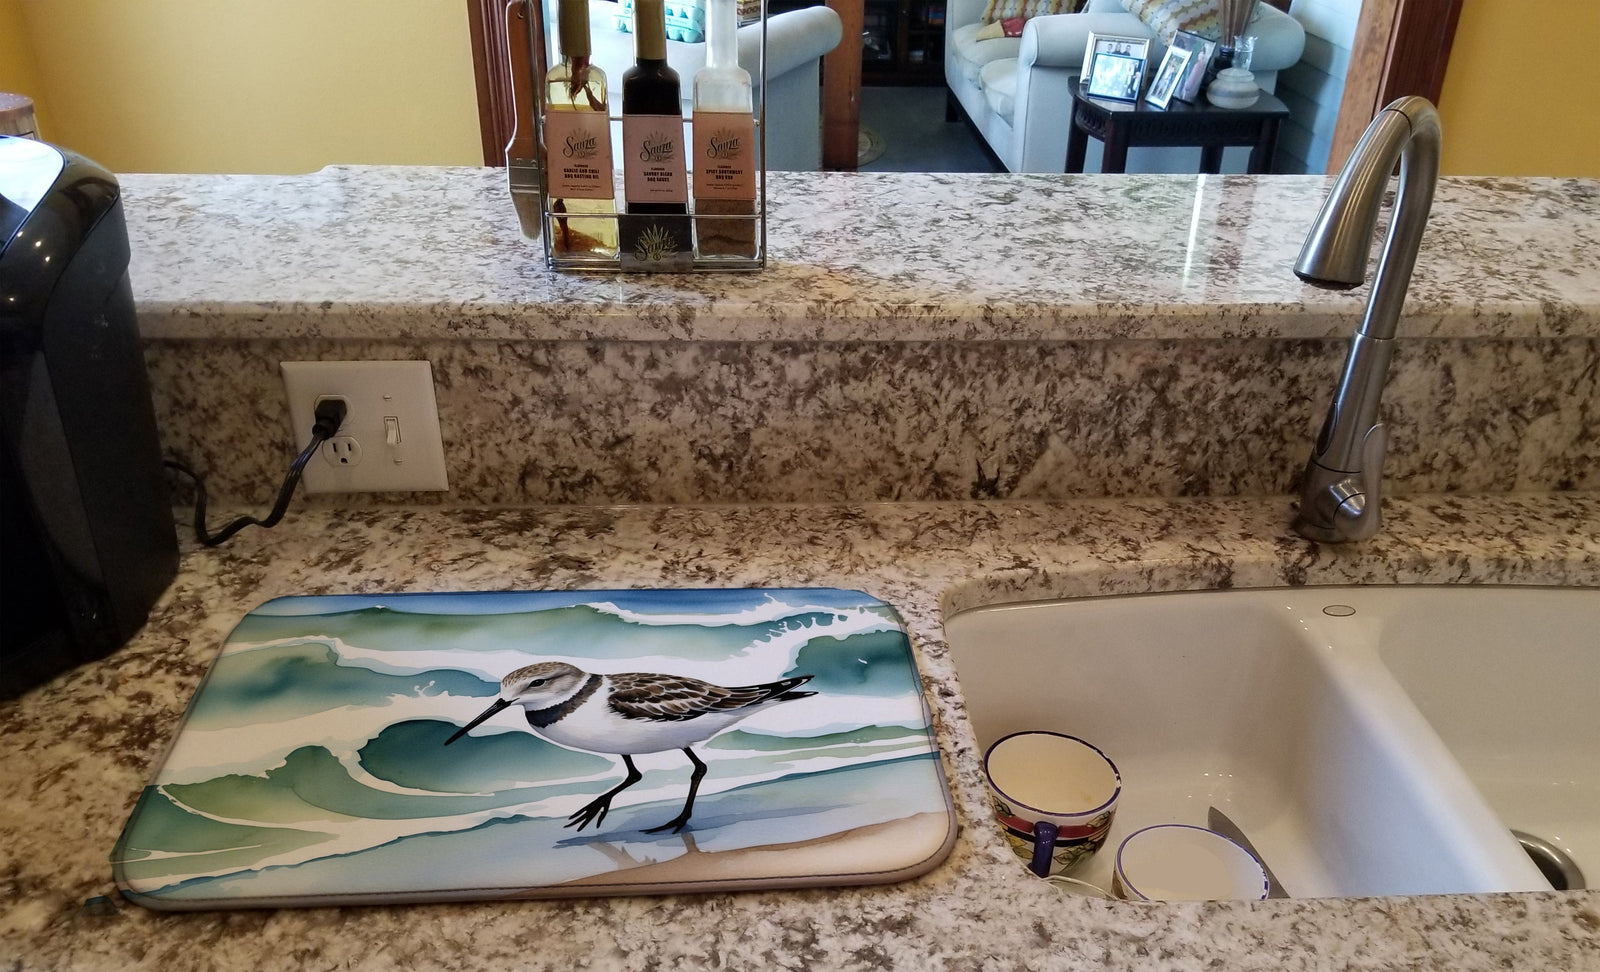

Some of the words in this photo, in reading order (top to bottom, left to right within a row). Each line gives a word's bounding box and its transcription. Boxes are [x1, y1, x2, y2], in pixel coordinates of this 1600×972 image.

[563, 136, 597, 158] Sauza
[640, 140, 674, 161] Sauza
[707, 137, 740, 158] Sauza
